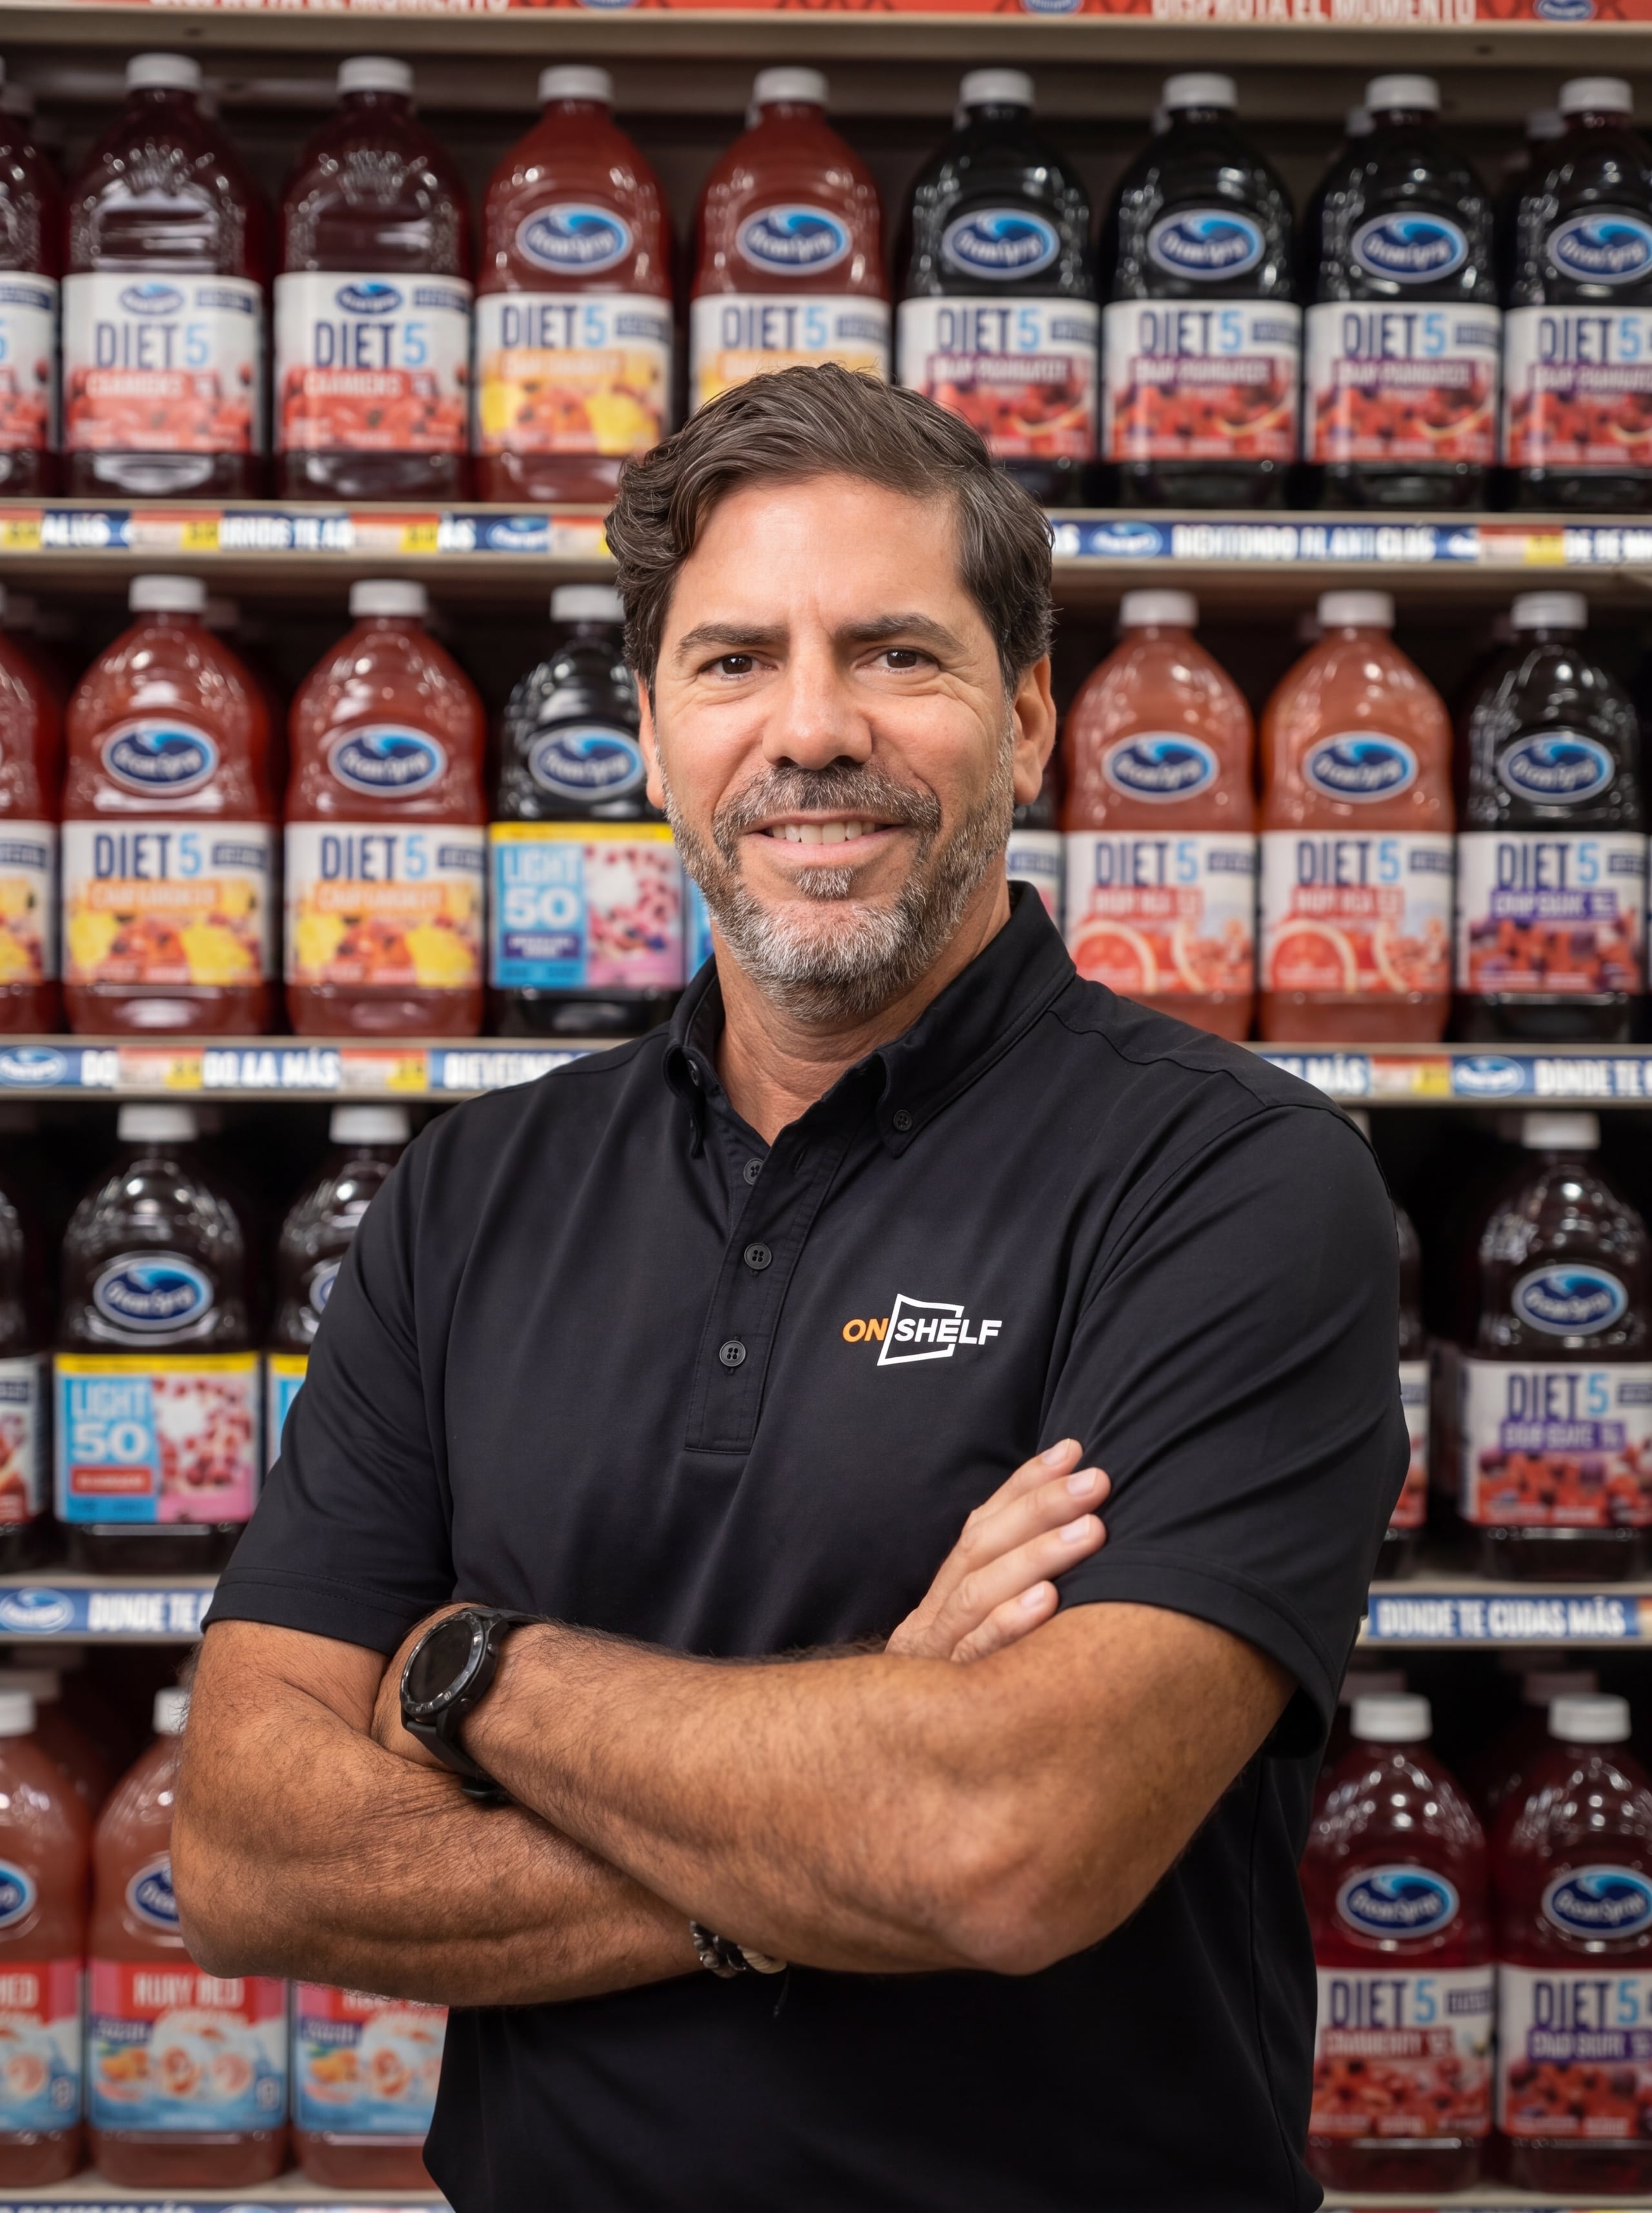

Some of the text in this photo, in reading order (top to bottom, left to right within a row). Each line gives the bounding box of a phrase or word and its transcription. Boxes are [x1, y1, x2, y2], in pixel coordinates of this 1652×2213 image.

[95, 321, 208, 369] DIET 5
[314, 321, 427, 369] DIET 5
[500, 305, 607, 349] DIET 5
[723, 305, 827, 349] DIET 5
[938, 308, 1040, 354] DIET 5
[1140, 311, 1242, 356] DIET 5
[1343, 313, 1446, 359] DIET 5
[1538, 318, 1641, 362] DIET 5
[94, 833, 201, 879] DIET 5
[322, 835, 427, 881] DIET 5
[503, 846, 579, 884] LIGHT
[1097, 840, 1198, 885] DIET 5
[1298, 840, 1400, 885] DIET 5
[1498, 842, 1598, 888] DIET 5
[503, 888, 578, 929] 50
[842, 1318, 1002, 1345] ON SHELF
[71, 1380, 146, 1419] LIGHT
[1508, 1373, 1609, 1421] DIET 5
[74, 1422, 149, 1461] 50
[1329, 1979, 1409, 2030] DIET
[1415, 1979, 1437, 2023] 5
[1535, 1979, 1611, 2031] DIET
[1618, 1979, 1640, 2024] 5
